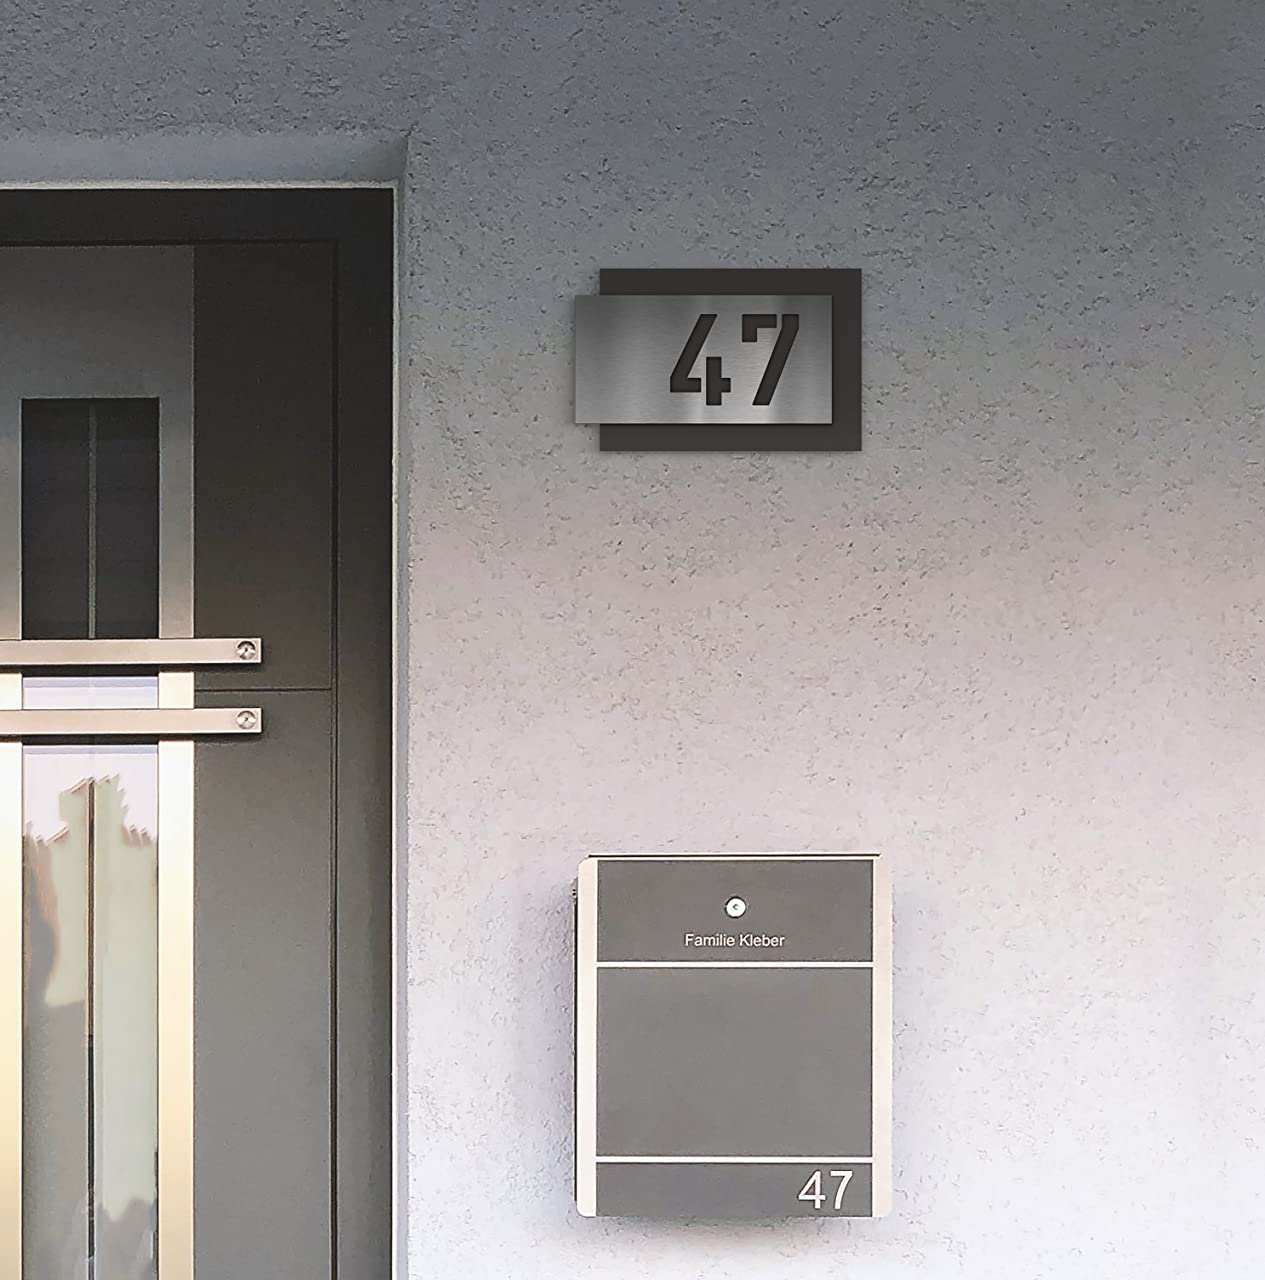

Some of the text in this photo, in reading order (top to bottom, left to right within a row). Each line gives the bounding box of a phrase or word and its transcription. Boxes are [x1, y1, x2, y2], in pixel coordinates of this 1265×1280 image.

[670, 313, 799, 406] 47
[685, 933, 785, 947] Familie Kleber
[798, 1170, 853, 1209] 47
